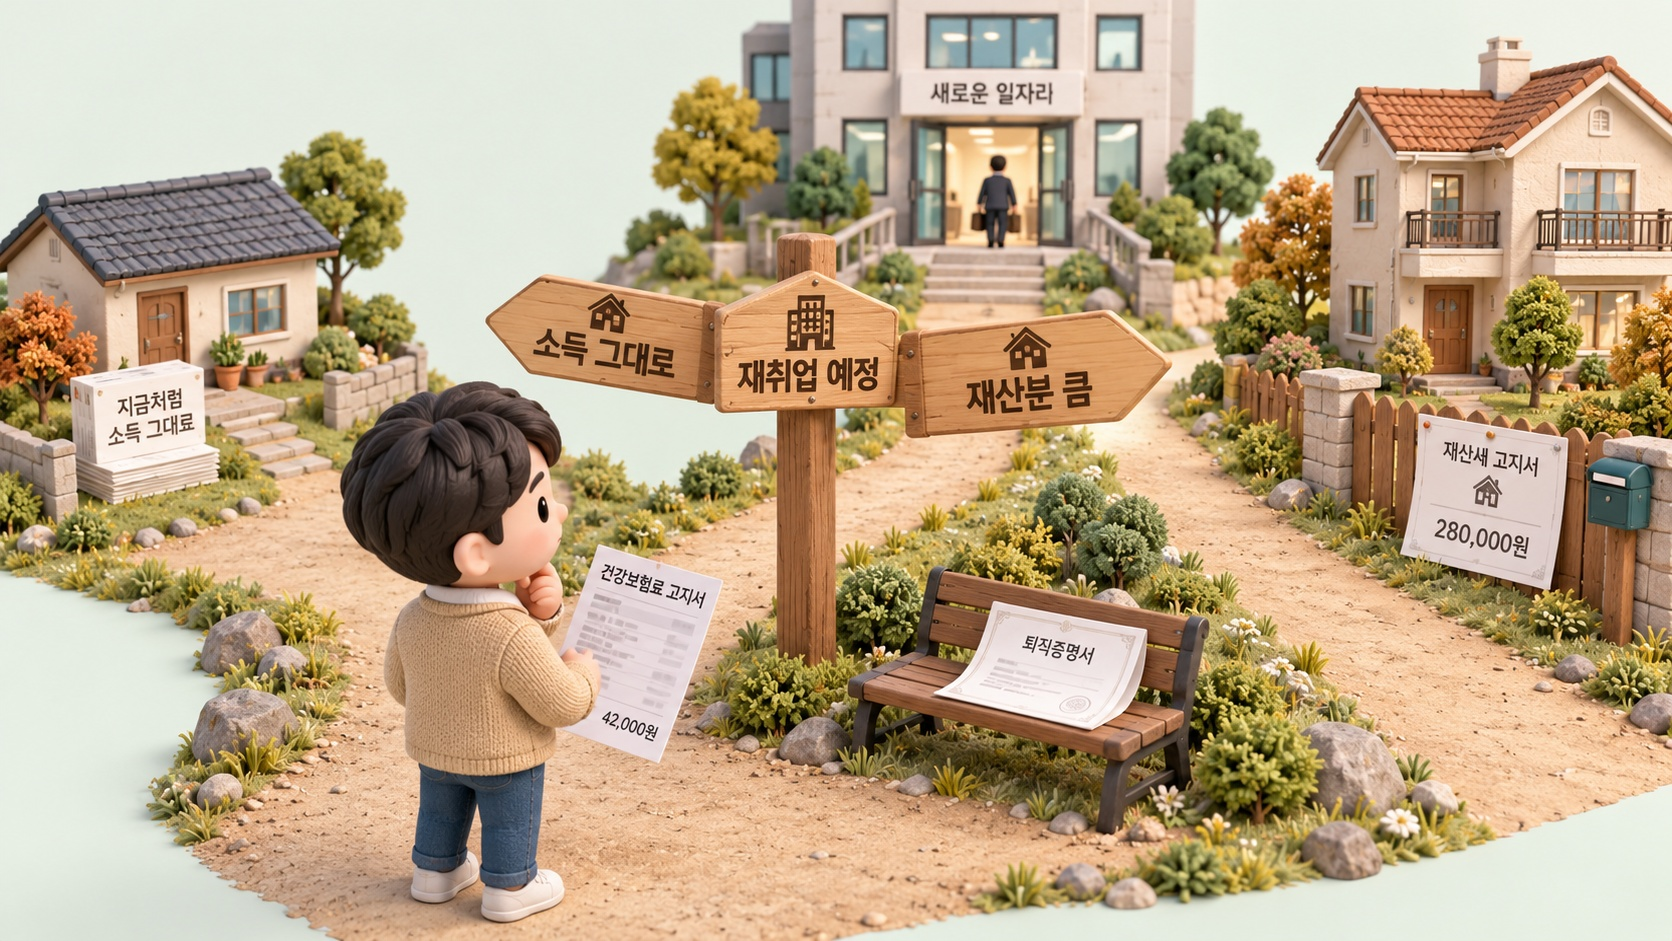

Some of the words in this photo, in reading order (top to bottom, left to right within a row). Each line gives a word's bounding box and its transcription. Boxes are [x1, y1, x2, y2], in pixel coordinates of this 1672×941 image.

[931, 82, 988, 104] 새로운
[533, 328, 588, 366] 소득
[595, 338, 675, 378] 그대로
[737, 358, 817, 393] 재취업
[827, 357, 879, 391] 예정
[966, 374, 1054, 414] 재산분
[1062, 371, 1092, 408] 큼
[117, 388, 182, 417] 지금처럼
[108, 422, 141, 446] 소득
[1443, 441, 1488, 467] 재산새
[1493, 451, 1539, 477] 고지서
[1434, 519, 1530, 559] 280,000원
[601, 564, 664, 596] 건강보험료
[665, 584, 706, 609] 고지서
[1022, 635, 1095, 665] 퇴직증명서
[602, 711, 659, 742] 42,000원
